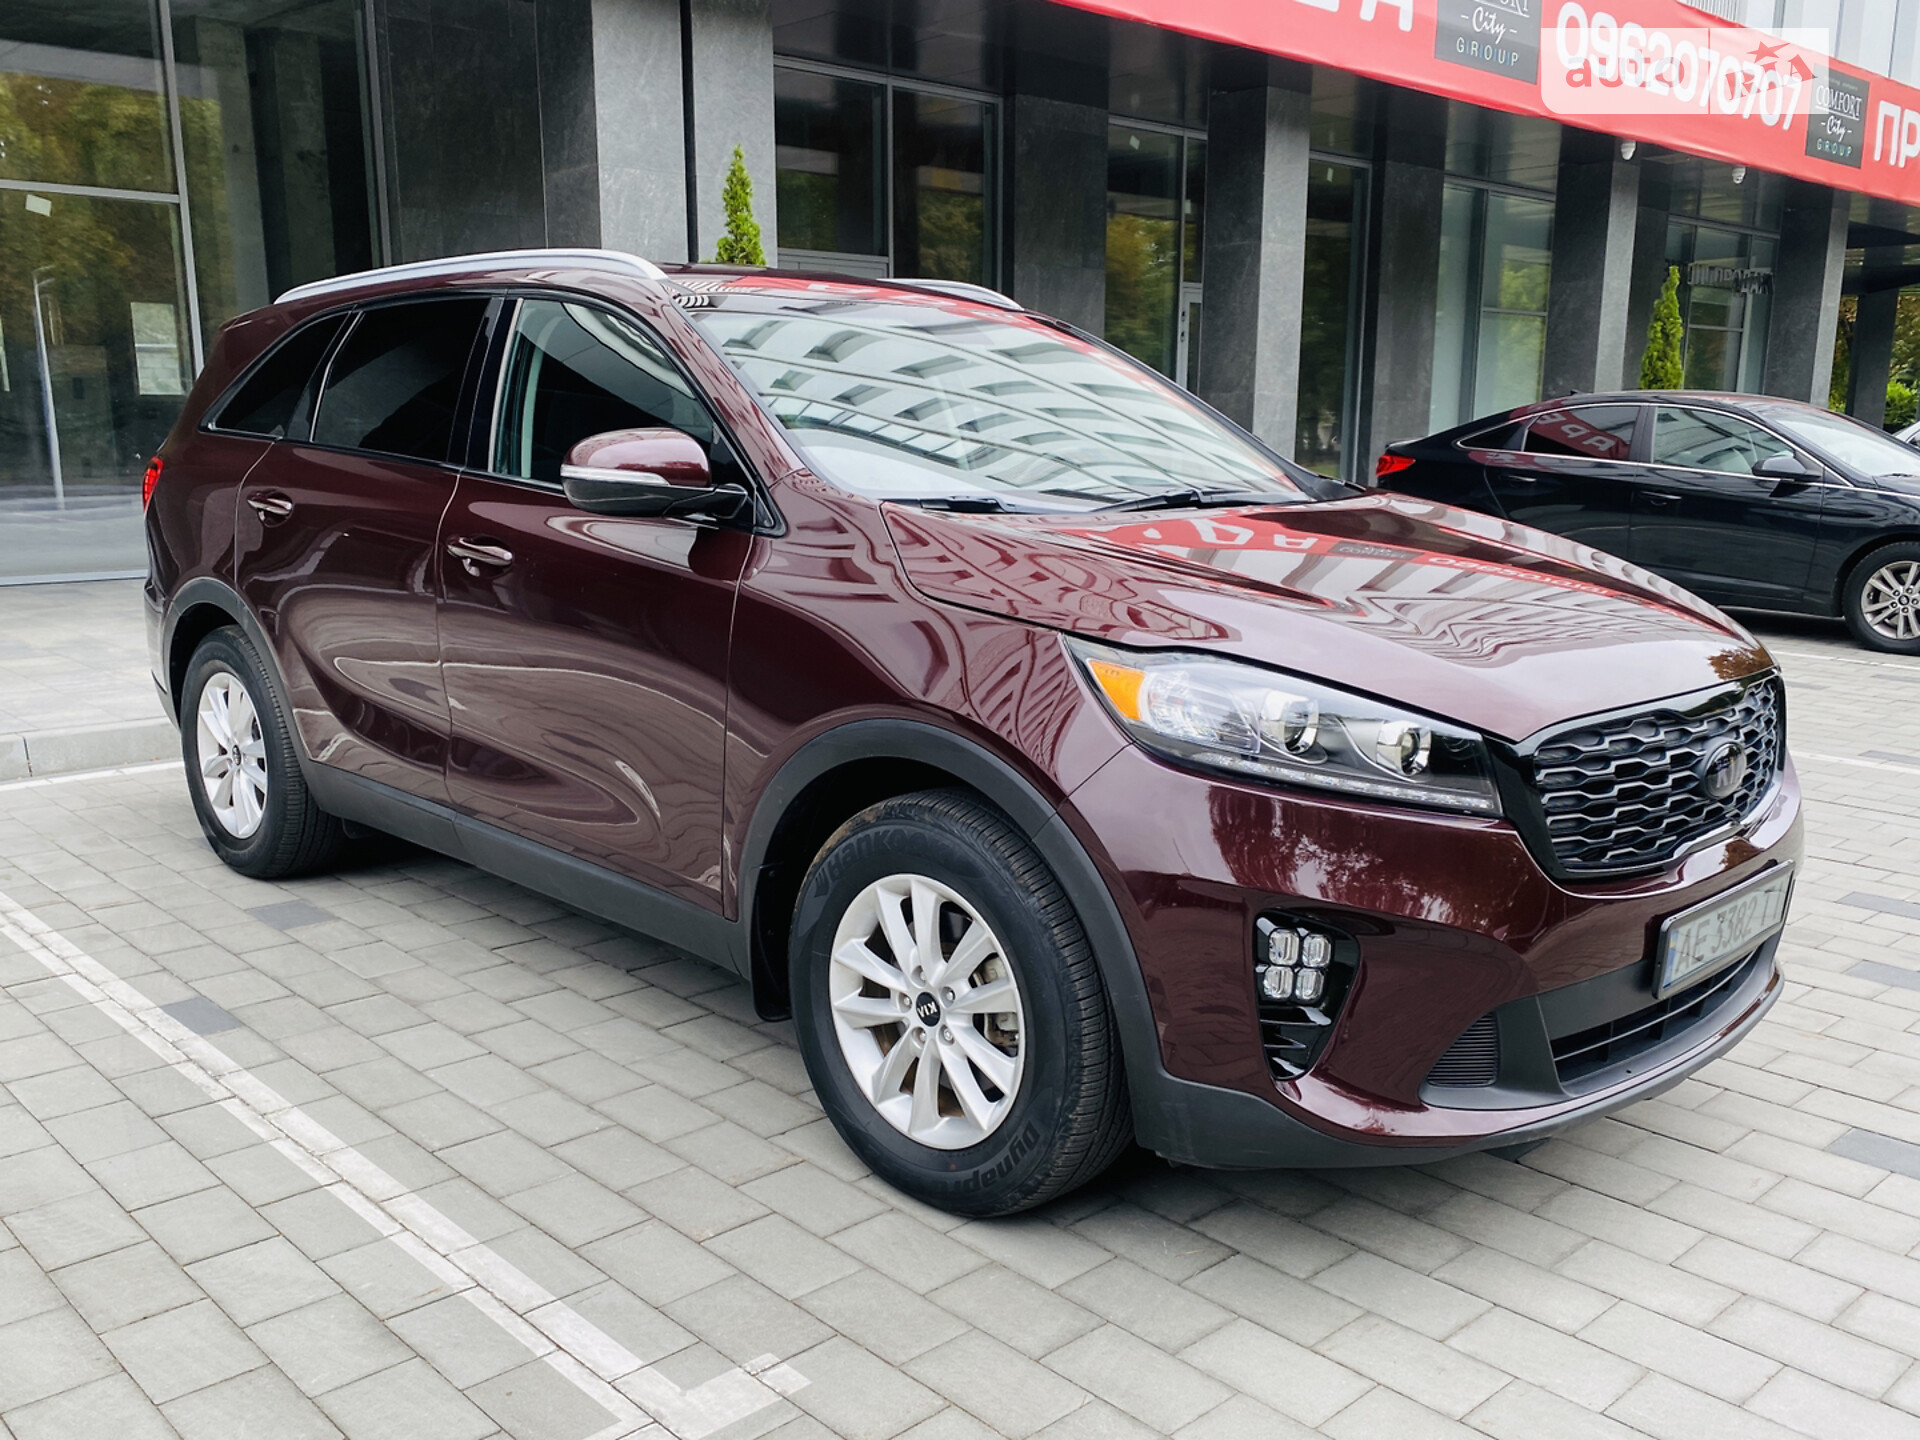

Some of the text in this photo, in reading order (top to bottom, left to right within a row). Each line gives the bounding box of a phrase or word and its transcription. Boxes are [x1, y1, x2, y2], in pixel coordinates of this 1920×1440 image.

[1472, 6, 1506, 44] City
[1456, 36, 1518, 67] GROUP
[1556, 2, 1801, 131] 0962070707
[1816, 85, 1862, 119] COMFORT
[1826, 115, 1847, 142] City
[1816, 138, 1853, 158] GROUP
[917, 1001, 938, 1018] KIA
